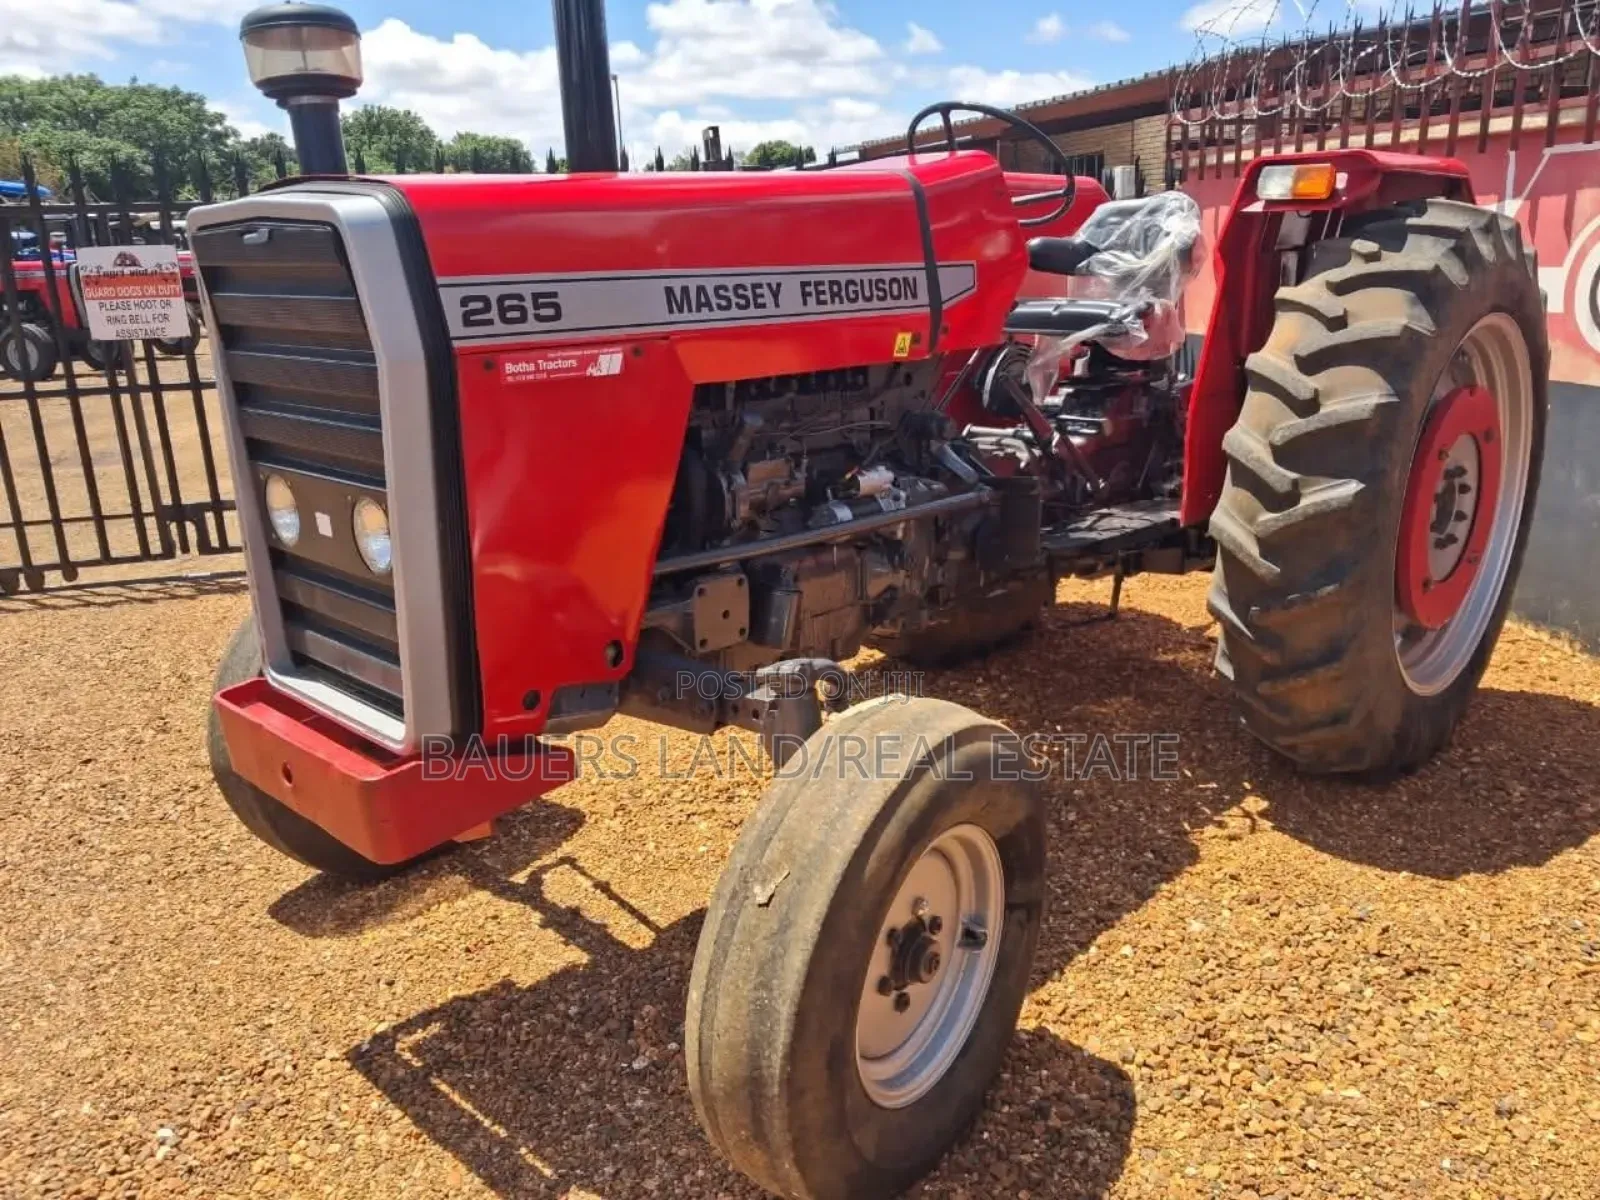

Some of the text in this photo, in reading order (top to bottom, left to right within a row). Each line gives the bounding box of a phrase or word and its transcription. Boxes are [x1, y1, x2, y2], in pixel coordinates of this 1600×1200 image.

[85, 284, 180, 299] GUARD DOGS ON DUTY
[99, 299, 172, 312] PLEASE HOOT OR
[459, 276, 918, 328] 265 MASSEY FERGUSON
[106, 313, 170, 326] RING BELL FOR
[115, 327, 168, 338] ASSISTANCE
[505, 359, 578, 374] Botha Tractors
